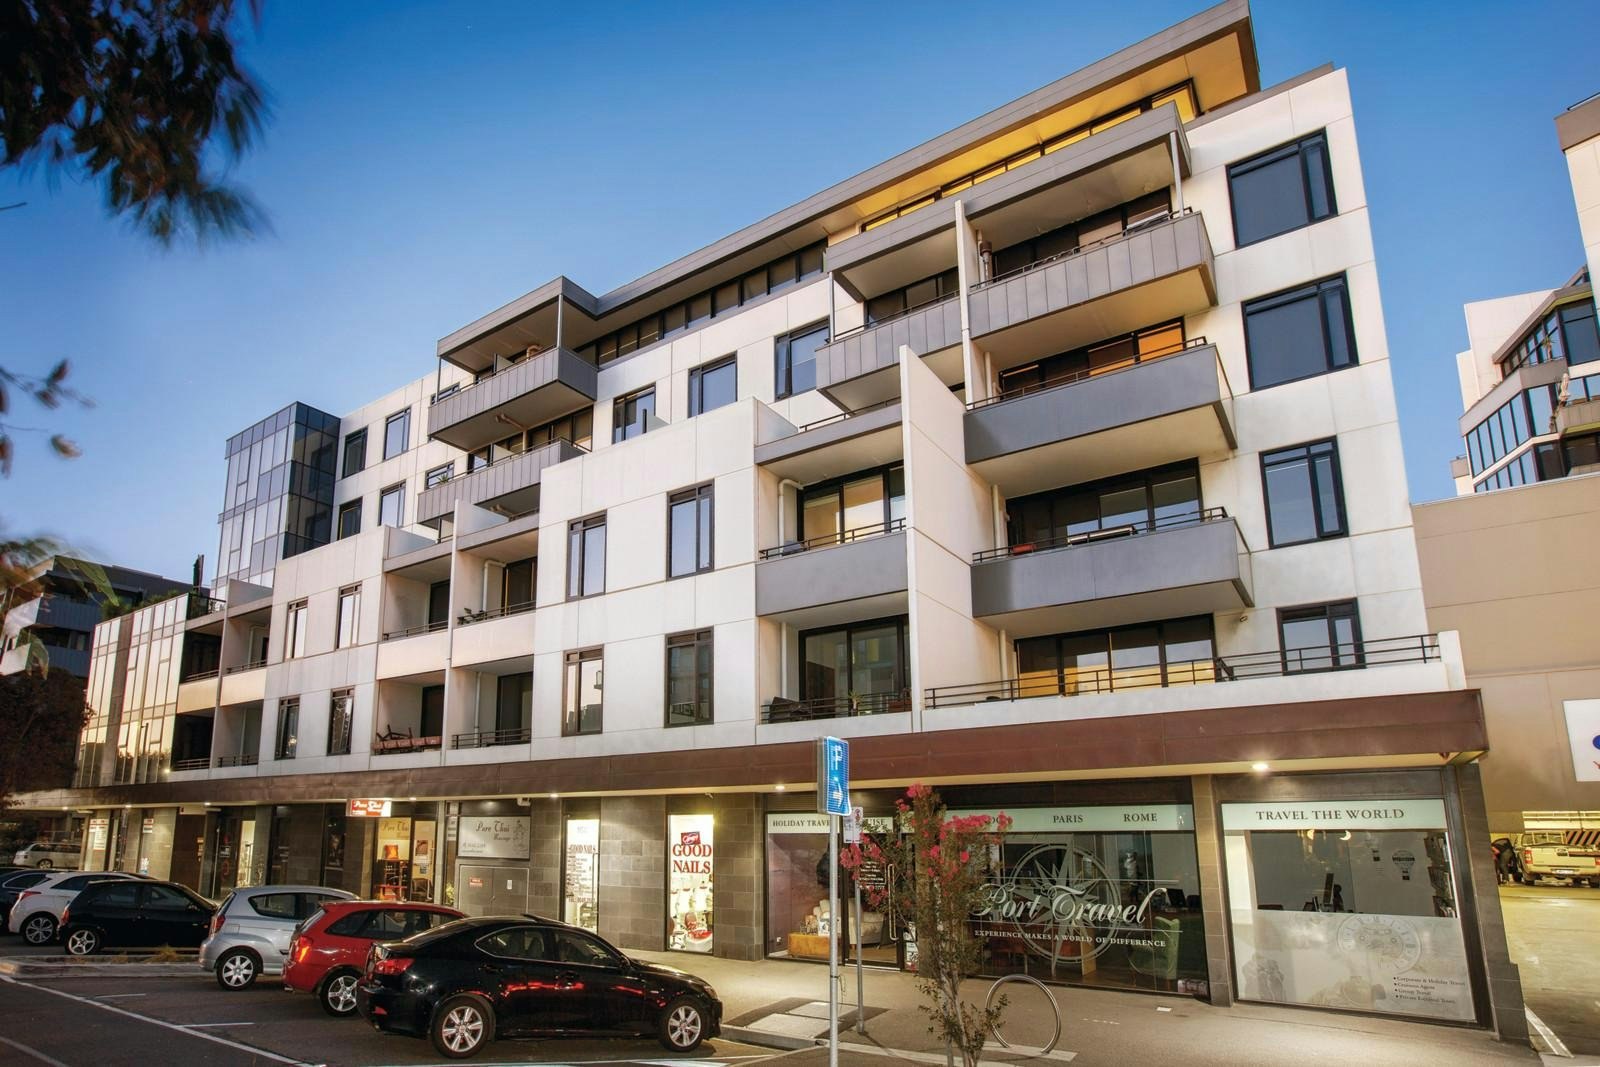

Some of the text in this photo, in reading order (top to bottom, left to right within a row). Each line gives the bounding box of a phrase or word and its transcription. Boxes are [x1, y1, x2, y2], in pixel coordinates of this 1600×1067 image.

[831, 744, 843, 771] P
[1053, 814, 1084, 824] PARIS
[1123, 813, 1158, 823] ROME
[1255, 808, 1405, 820] TRAVEL THE WORLD
[772, 819, 830, 828] HOLIDAY TRAVE
[672, 843, 712, 857] GOOD
[672, 860, 711, 874] NAILS
[1046, 885, 1168, 925] Travel
[974, 930, 1022, 938] EXPERIENCE
[1025, 932, 1052, 940] MAKES
[1062, 935, 1093, 943] WORLD
[1110, 938, 1166, 947] DIFFERENCE
